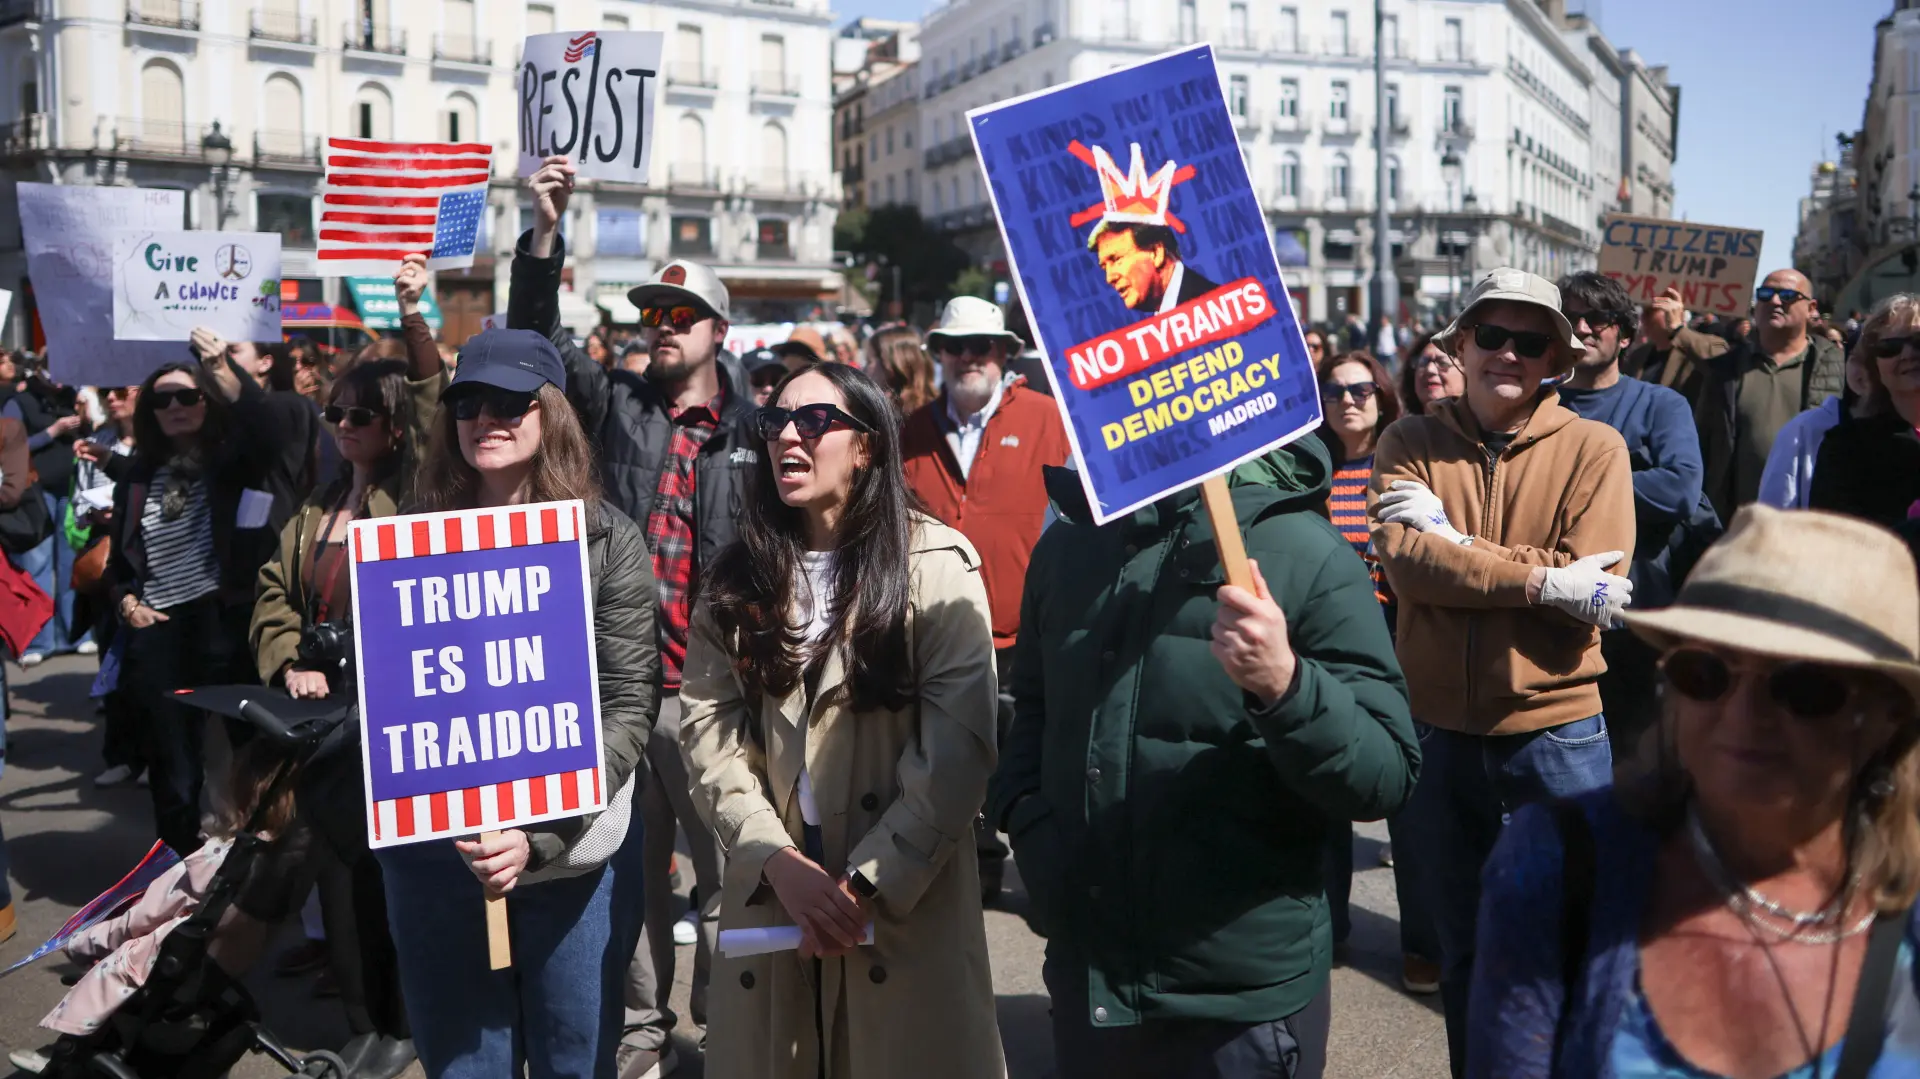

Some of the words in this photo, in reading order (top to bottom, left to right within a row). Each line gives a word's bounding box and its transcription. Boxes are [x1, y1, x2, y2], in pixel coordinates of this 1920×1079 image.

[522, 38, 656, 168] RESIST
[145, 243, 198, 272] Give
[1604, 220, 1760, 257] CITIZENS
[1632, 247, 1727, 278] TRUMP
[154, 281, 170, 300] A
[1070, 340, 1125, 385] NO
[1126, 282, 1267, 361] TYRANTS
[1101, 354, 1281, 451] DEMOCRACY
[1128, 341, 1244, 407] DEFEND
[1208, 392, 1277, 436] MADRID
[392, 565, 551, 627] TRUMP
[411, 645, 466, 697] ES
[484, 635, 545, 687] UN
[382, 702, 582, 774] TRAIDOR
